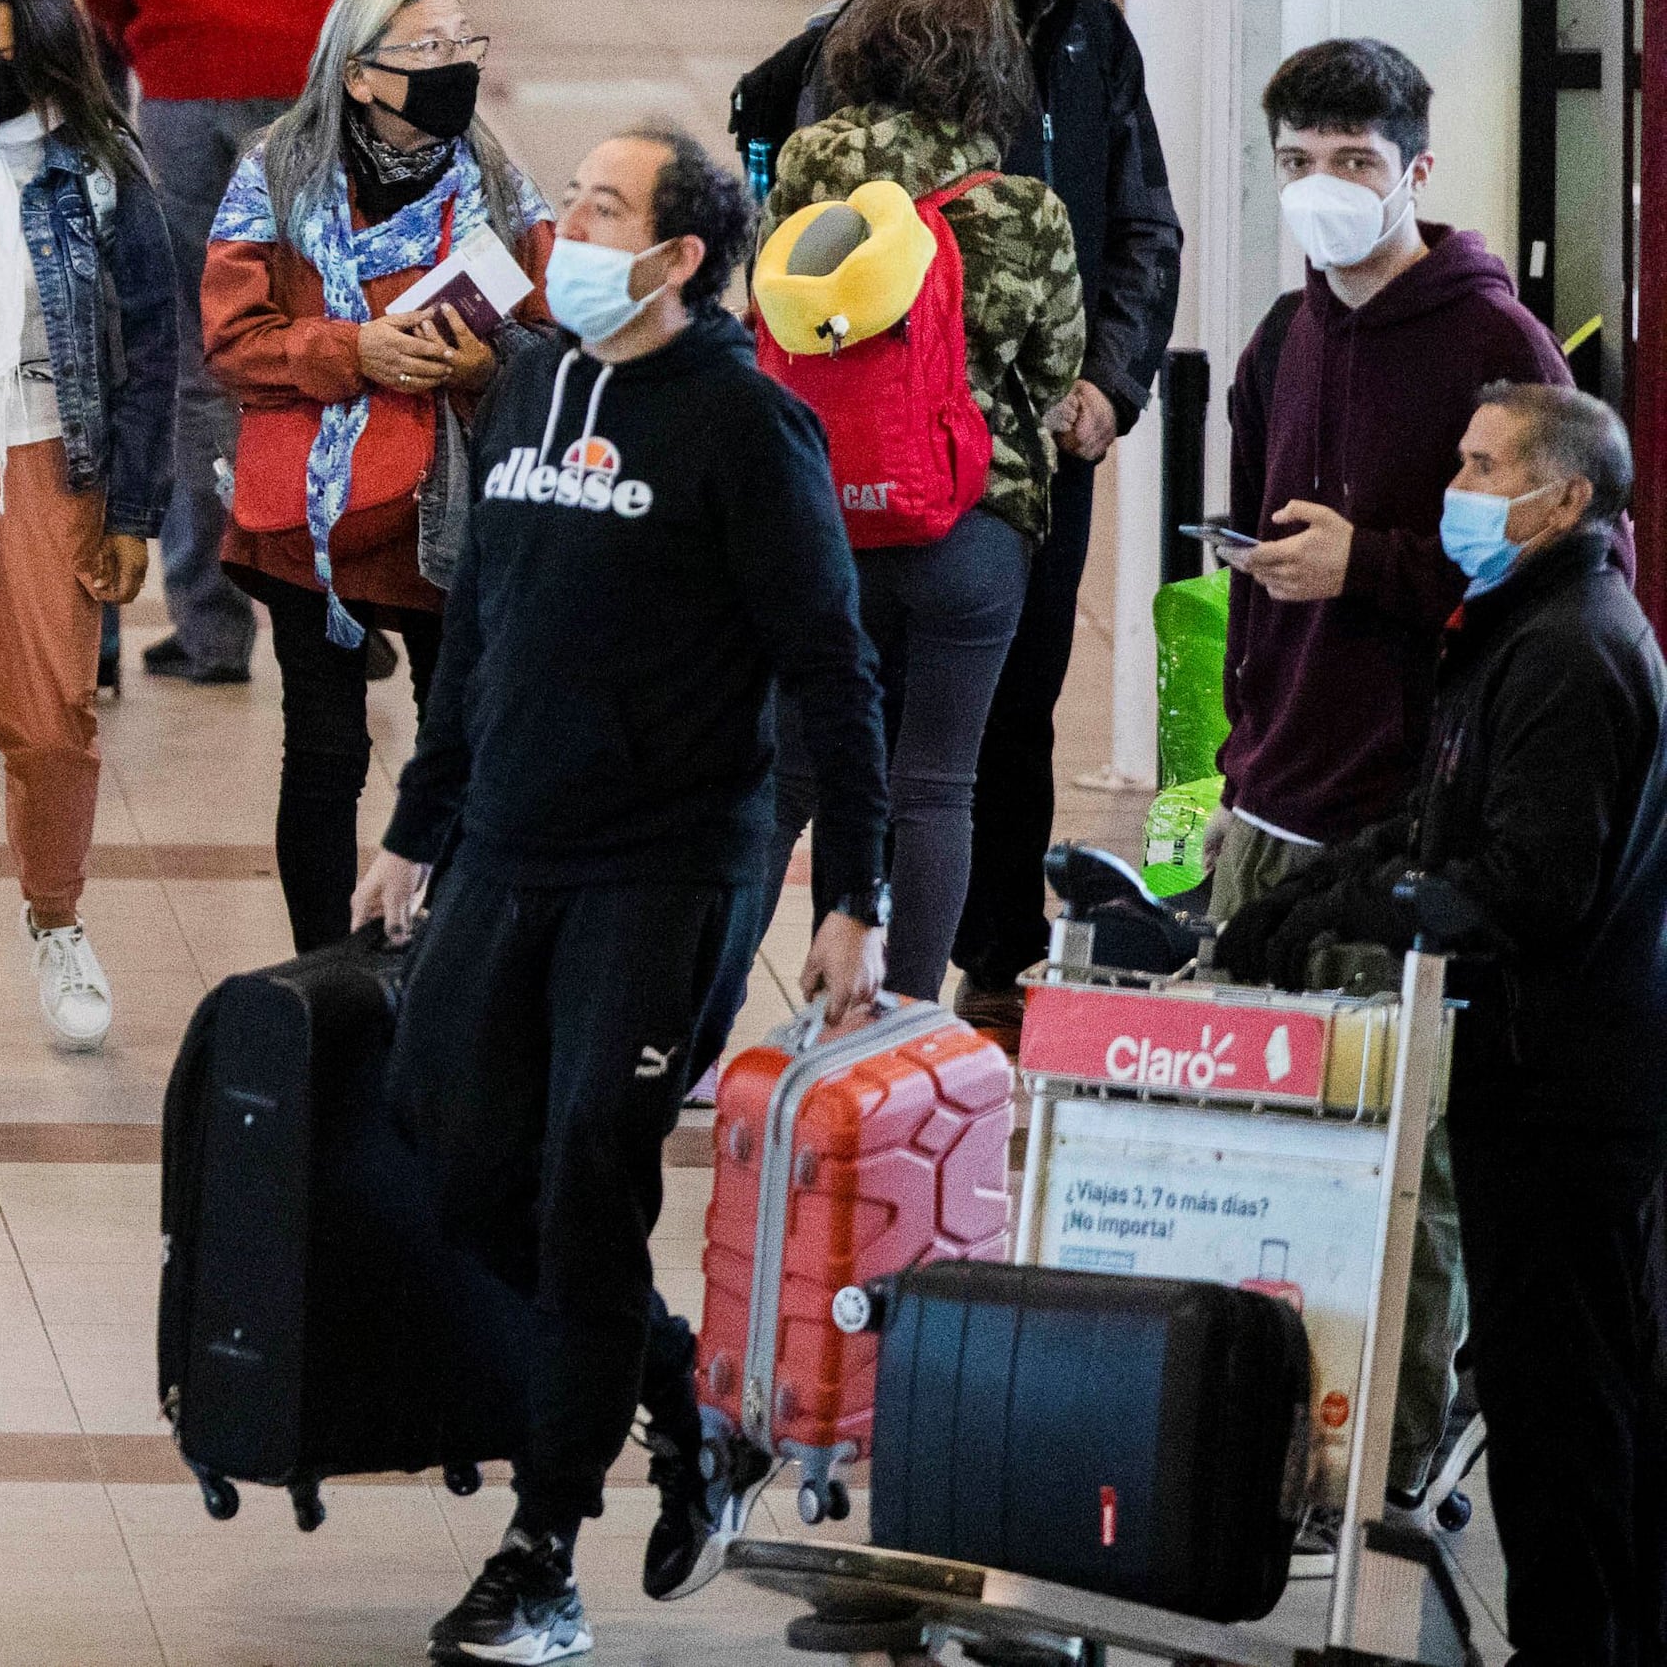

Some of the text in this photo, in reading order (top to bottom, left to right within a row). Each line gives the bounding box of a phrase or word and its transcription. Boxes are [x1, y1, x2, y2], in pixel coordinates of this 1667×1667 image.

[484, 447, 654, 518] ellesse
[843, 482, 887, 510] CAT
[1105, 1031, 1218, 1089] Claro
[1066, 1180, 1128, 1206] ¿Viajas
[1151, 1186, 1163, 1207] 7
[1167, 1192, 1177, 1209] o
[1179, 1190, 1218, 1213] más
[1221, 1190, 1270, 1218] días?
[1097, 1215, 1175, 1239] importa!
